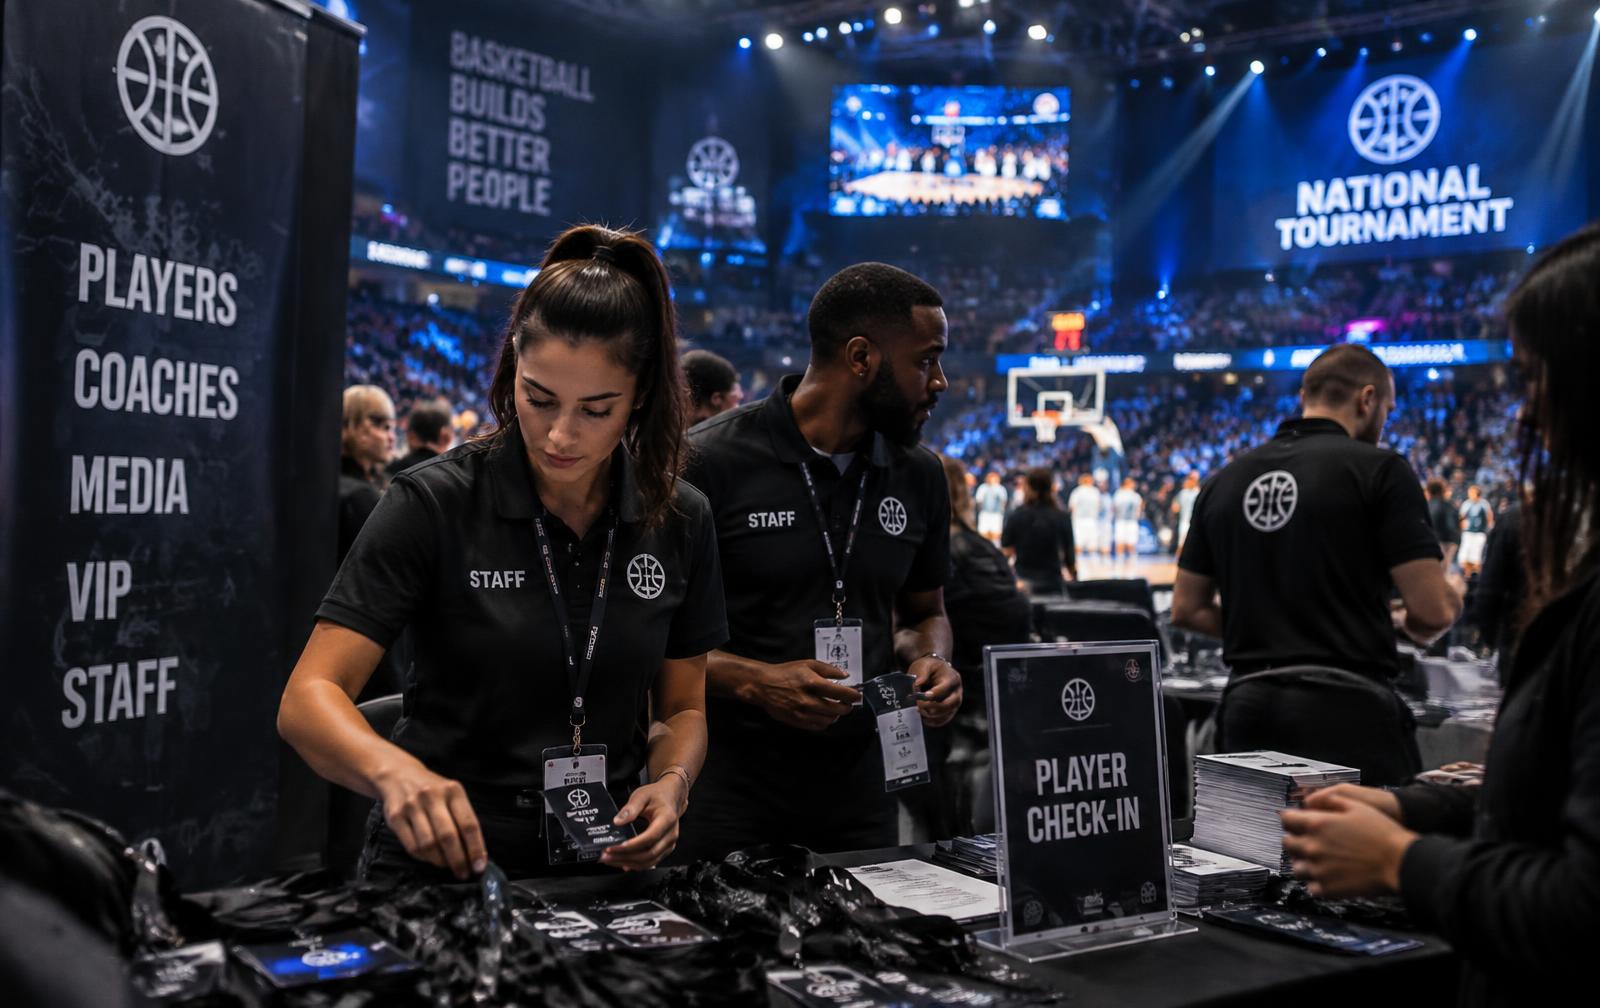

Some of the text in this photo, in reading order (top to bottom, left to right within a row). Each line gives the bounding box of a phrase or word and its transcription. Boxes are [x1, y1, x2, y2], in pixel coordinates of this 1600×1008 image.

[449, 30, 595, 103] BASKETBALL
[449, 73, 547, 132] BUILDS
[447, 116, 551, 173] BETTER
[446, 161, 552, 217] PEOPLE
[1296, 163, 1492, 216] NATIONAL
[1275, 197, 1514, 250] TOURNAMENT
[78, 242, 238, 327] PLAYERS
[74, 348, 240, 421] COACHES
[70, 455, 189, 515] MEDIA
[747, 510, 796, 528] STAFF
[66, 560, 132, 622] VIP
[469, 570, 526, 589] STAFF
[61, 656, 179, 729] STAFF
[1035, 752, 1128, 797] PLAYER
[1027, 796, 1141, 844] CHECK-IN
